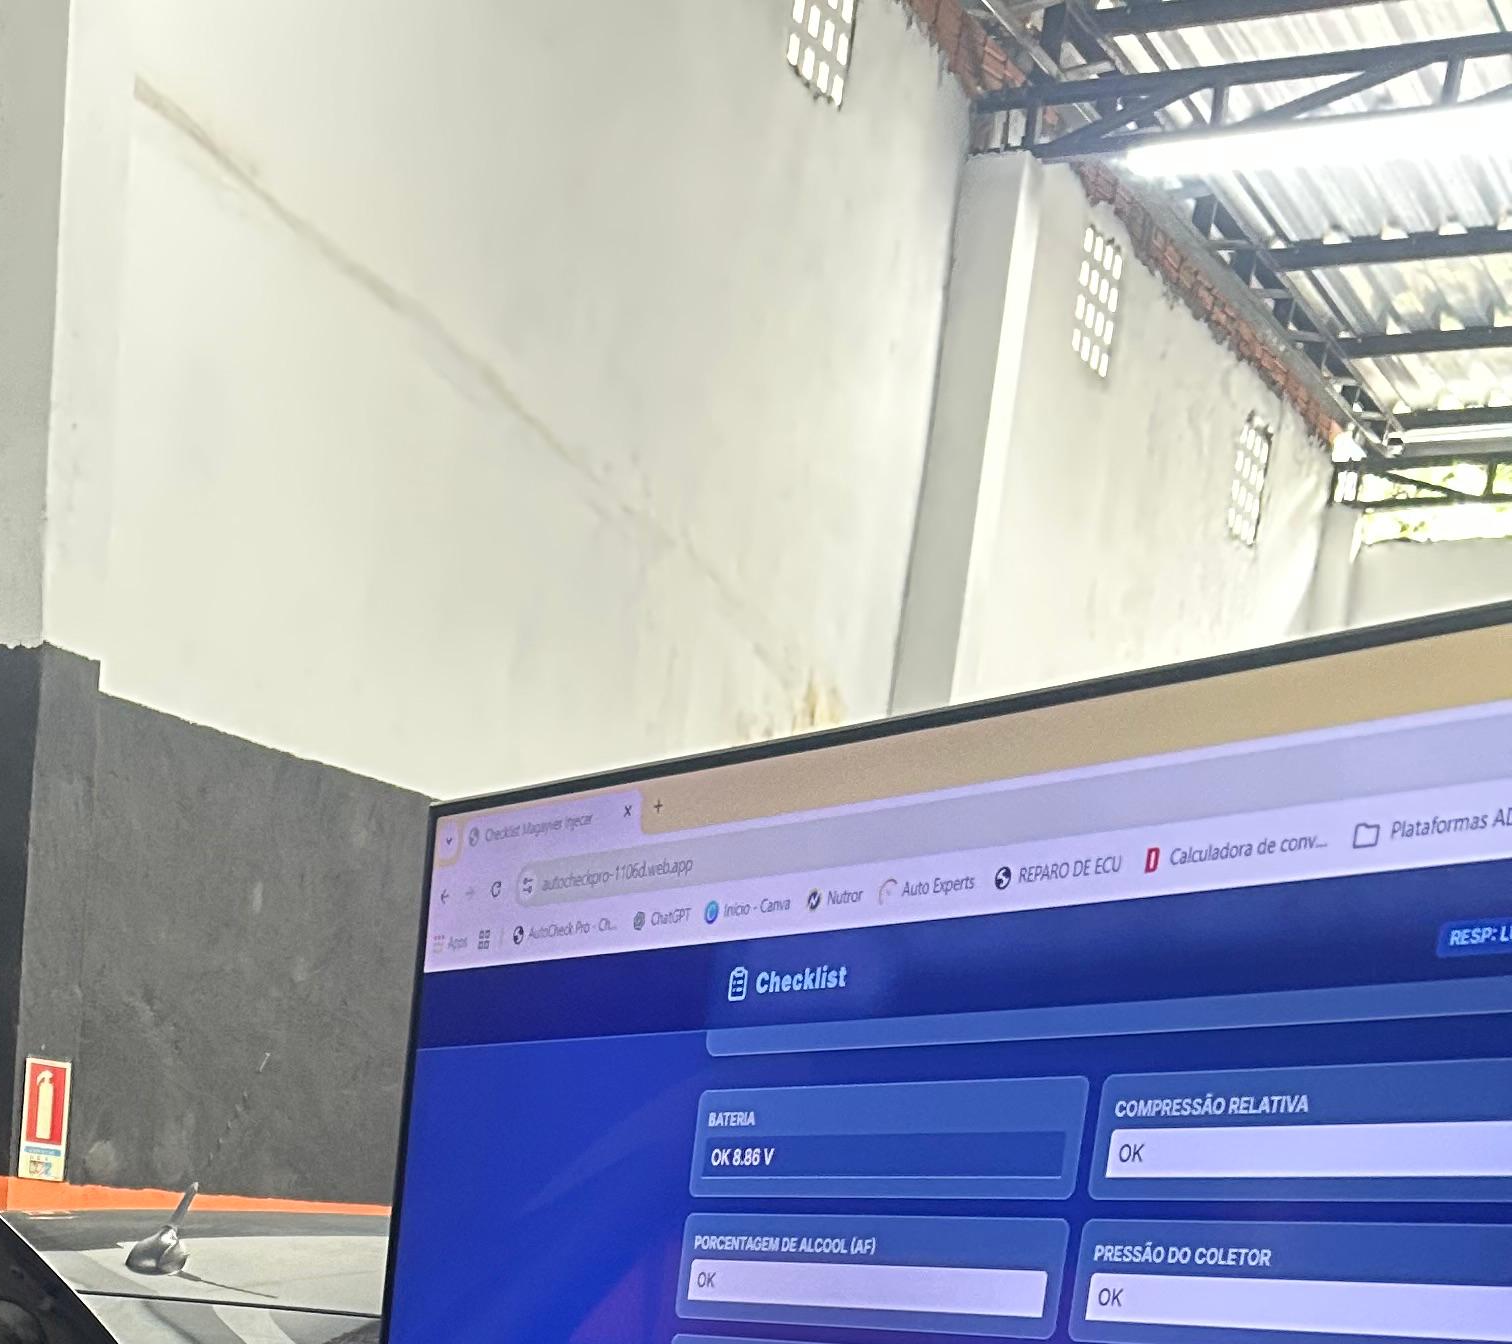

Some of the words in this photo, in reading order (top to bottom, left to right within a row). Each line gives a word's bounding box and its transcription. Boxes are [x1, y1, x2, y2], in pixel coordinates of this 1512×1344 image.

[1391, 814, 1488, 839] Plataformas
[1170, 840, 1254, 867] Calculadora
[1257, 838, 1277, 857] de
[1018, 862, 1070, 884] REPARO
[1073, 859, 1091, 878] DE
[1094, 855, 1123, 876] ECU
[901, 880, 930, 897] Auto
[933, 875, 976, 895] Experts
[760, 898, 791, 914] Canva
[827, 889, 864, 906] Nutror
[651, 907, 693, 926] ChatGPT
[1449, 926, 1498, 946] RESP:
[756, 964, 848, 995] Checklist
[1115, 1093, 1226, 1117] COMPRESSÃO
[1228, 1094, 1309, 1115] RELATIVA
[708, 1110, 755, 1128] BATERIA
[711, 1148, 730, 1166] OK
[732, 1147, 761, 1166] 8.86
[763, 1147, 775, 1166] V
[1118, 1143, 1144, 1163] OK
[694, 1234, 780, 1253] PORCENTAGEM
[782, 1236, 799, 1253] DE
[850, 1237, 877, 1256] (AF)
[1094, 1241, 1165, 1264] PRESSÃO
[1167, 1247, 1192, 1264] DO
[1194, 1247, 1272, 1266] COLETOR
[697, 1271, 716, 1288] OK
[1098, 1287, 1124, 1308] OK
